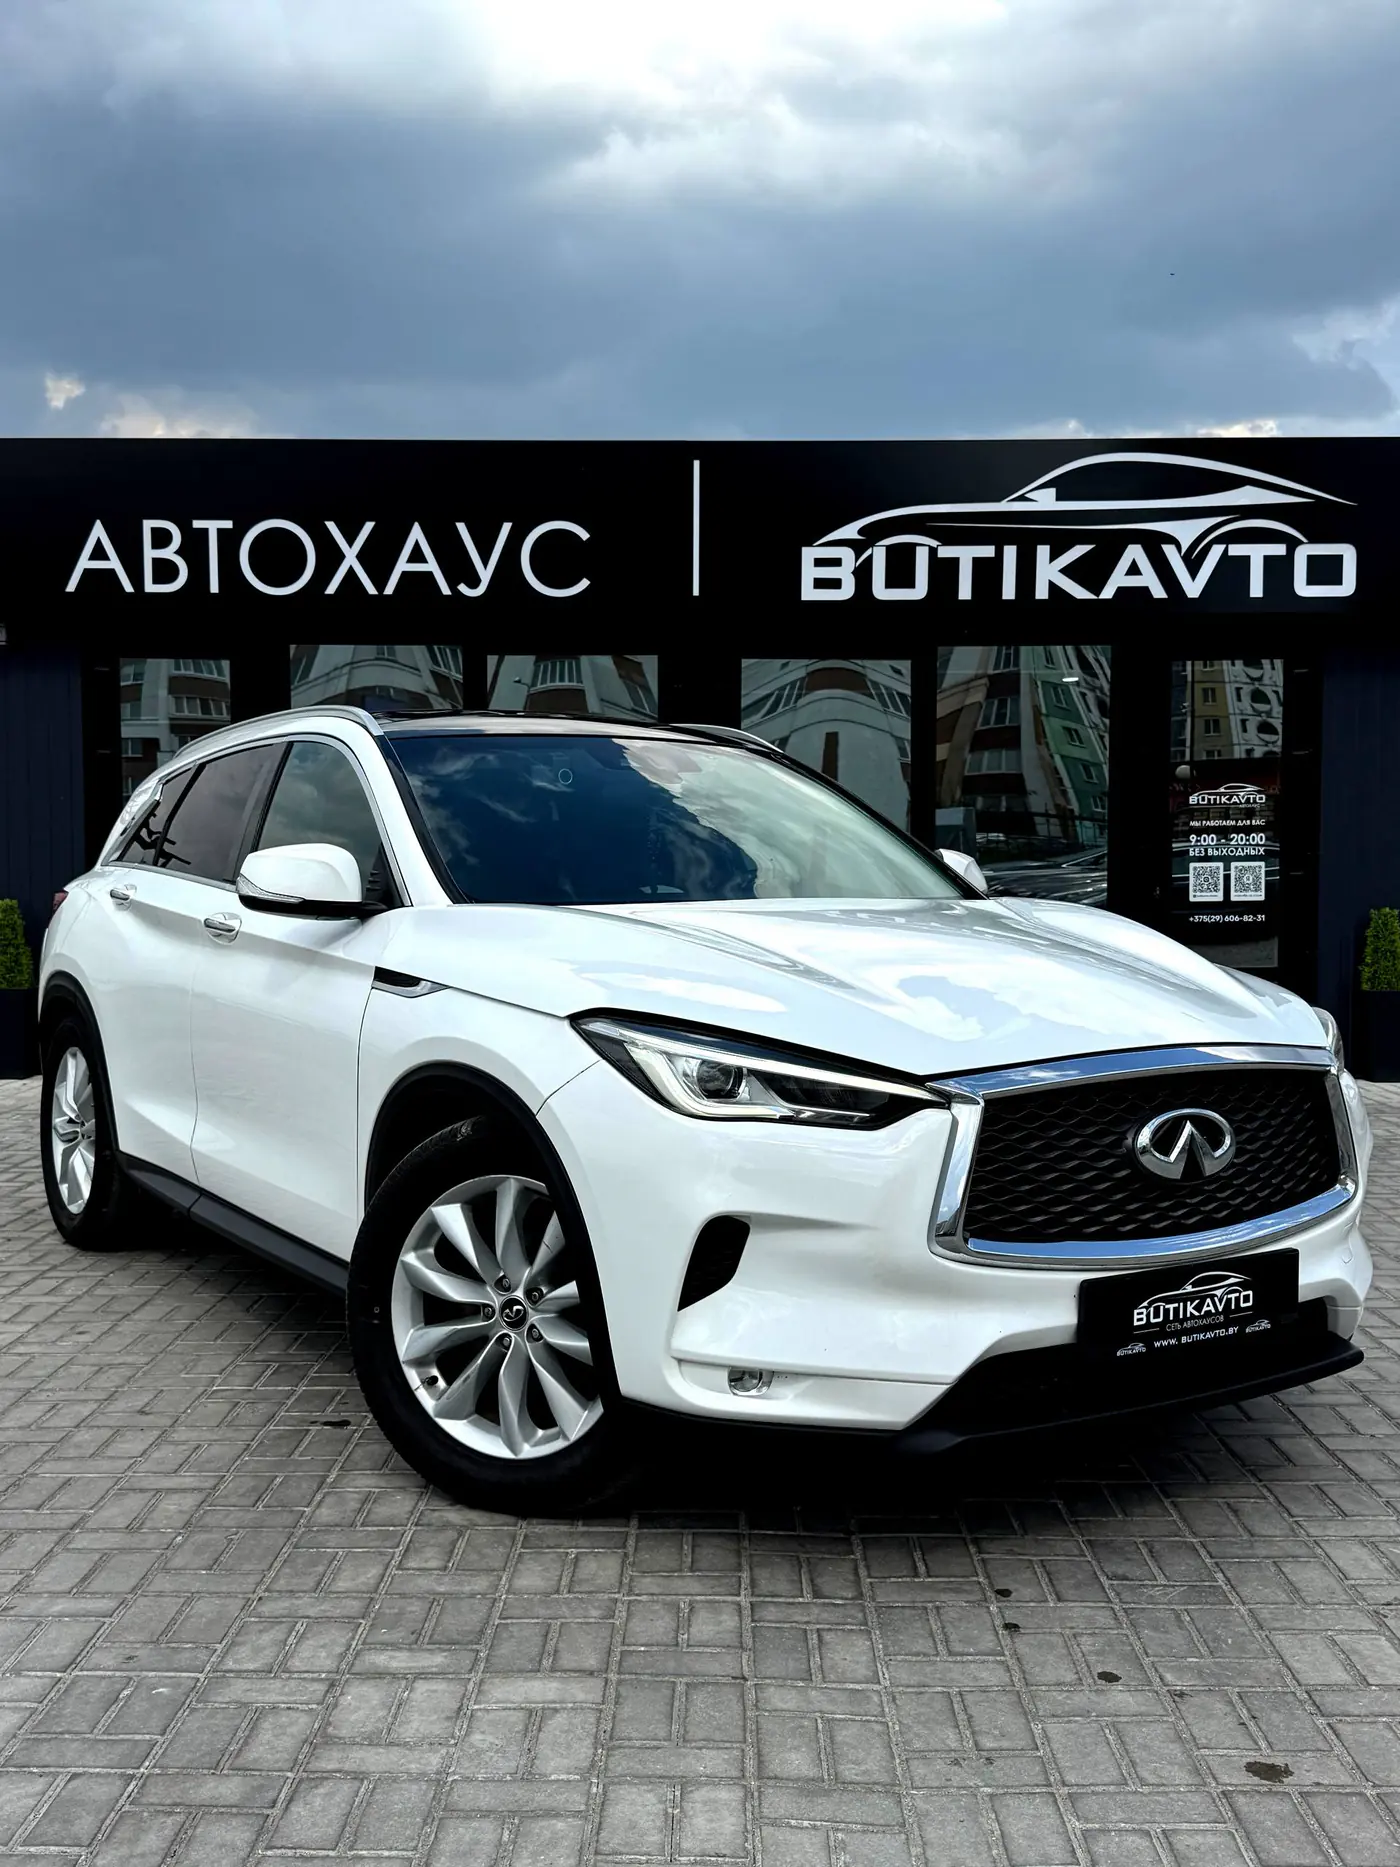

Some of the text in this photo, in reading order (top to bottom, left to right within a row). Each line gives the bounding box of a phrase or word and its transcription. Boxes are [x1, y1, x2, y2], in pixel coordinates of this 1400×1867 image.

[65, 518, 591, 598] АВТОХАУС
[801, 542, 1357, 601] BUTIKAVTO
[1189, 794, 1266, 804] BUTIKAVTO
[1189, 834, 1217, 845] 9:00
[1230, 833, 1266, 845] 20:00
[1189, 847, 1265, 857] БЕЗ ВЫХОДНЫХ
[1189, 914, 1266, 923] +375(29) 606-82-31
[1133, 1290, 1253, 1326] BUTIKAVTO
[1166, 1315, 1225, 1332] СЕТЬ АВТОХАУСОВ
[1245, 1323, 1272, 1333] BUTIKAVTO
[1154, 1326, 1239, 1348] WWW. BUTIKAVTO.BY
[1116, 1347, 1147, 1356] BUTIKAVTO
